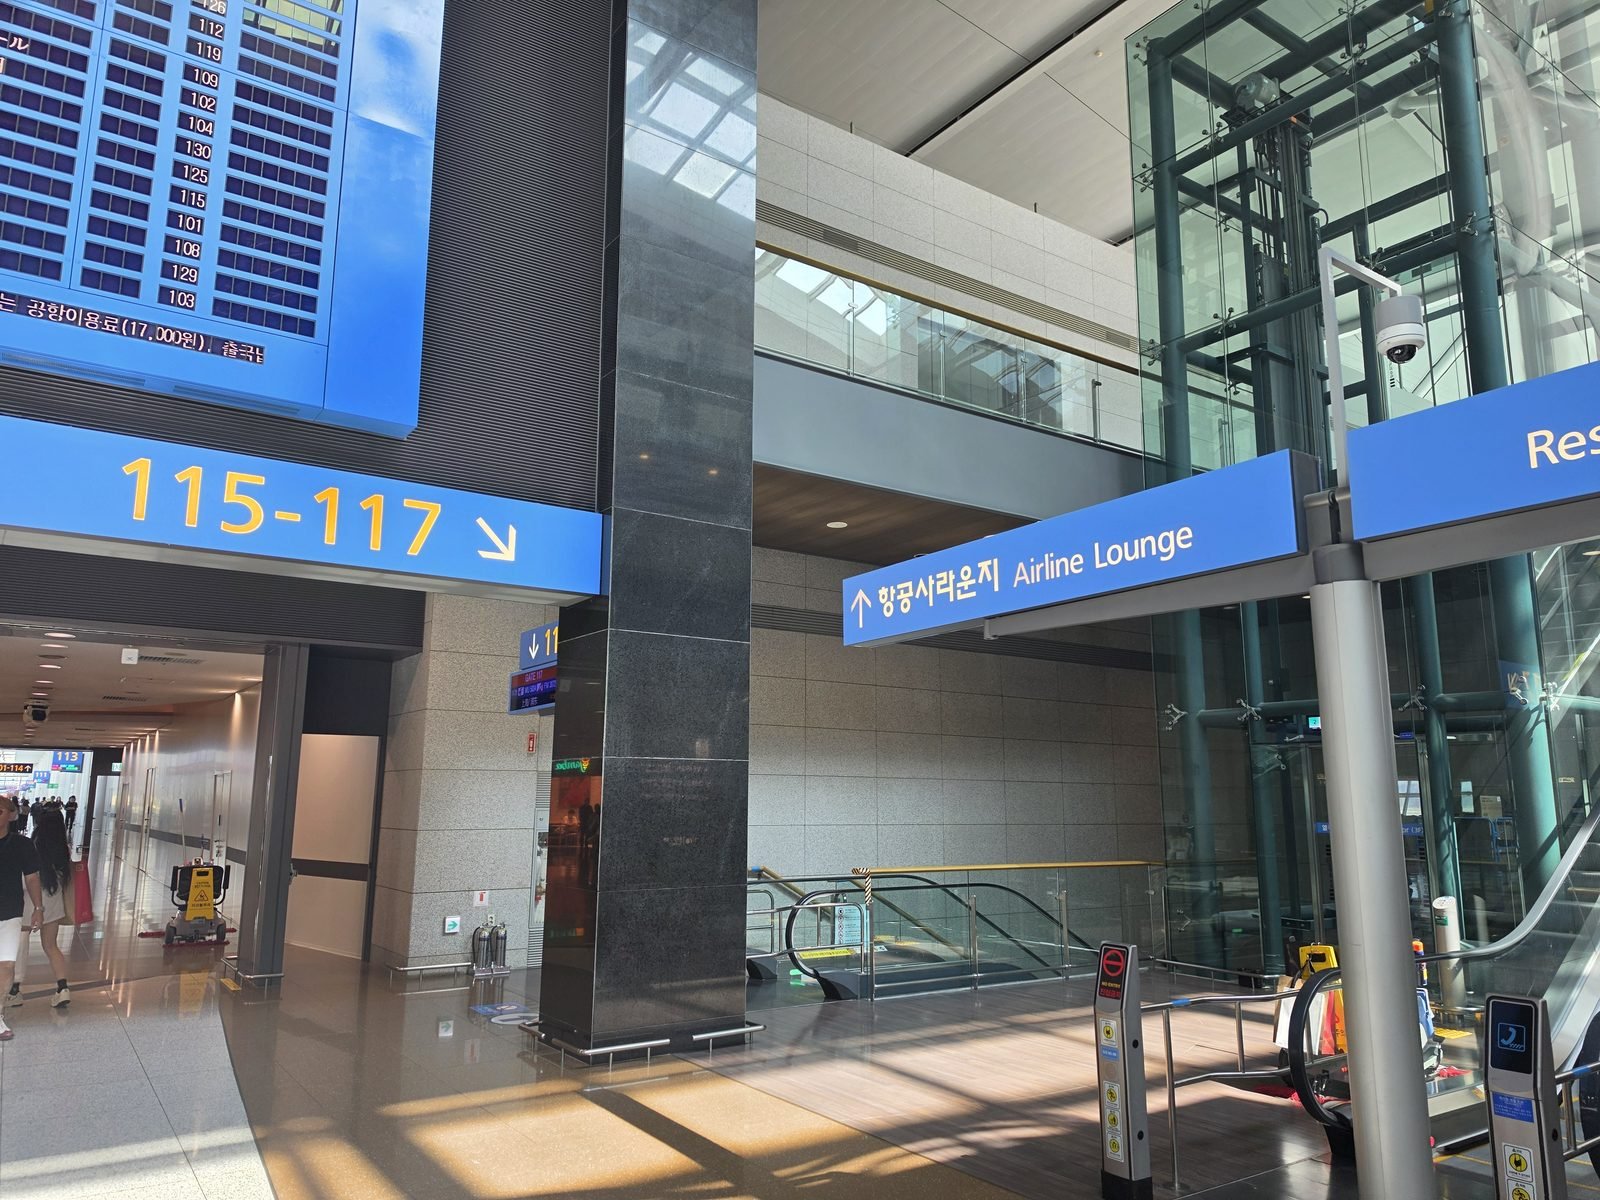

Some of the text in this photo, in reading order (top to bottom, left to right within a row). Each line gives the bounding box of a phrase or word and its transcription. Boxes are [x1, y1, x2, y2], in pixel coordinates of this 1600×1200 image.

[200, 18, 224, 38] 112
[197, 42, 221, 61] 119
[194, 68, 218, 87] 109
[191, 92, 216, 112] 102
[189, 116, 213, 135] 104
[186, 140, 212, 159] 130
[183, 164, 208, 184] 125
[181, 189, 205, 208] 115
[178, 214, 202, 233] 101
[175, 239, 200, 258] 108
[172, 264, 198, 283] 129
[169, 289, 195, 308] 103
[121, 457, 441, 557] 115-117
[878, 525, 1194, 618] 항공사라운지 Airline Lounge
[57, 751, 78, 761] 113
